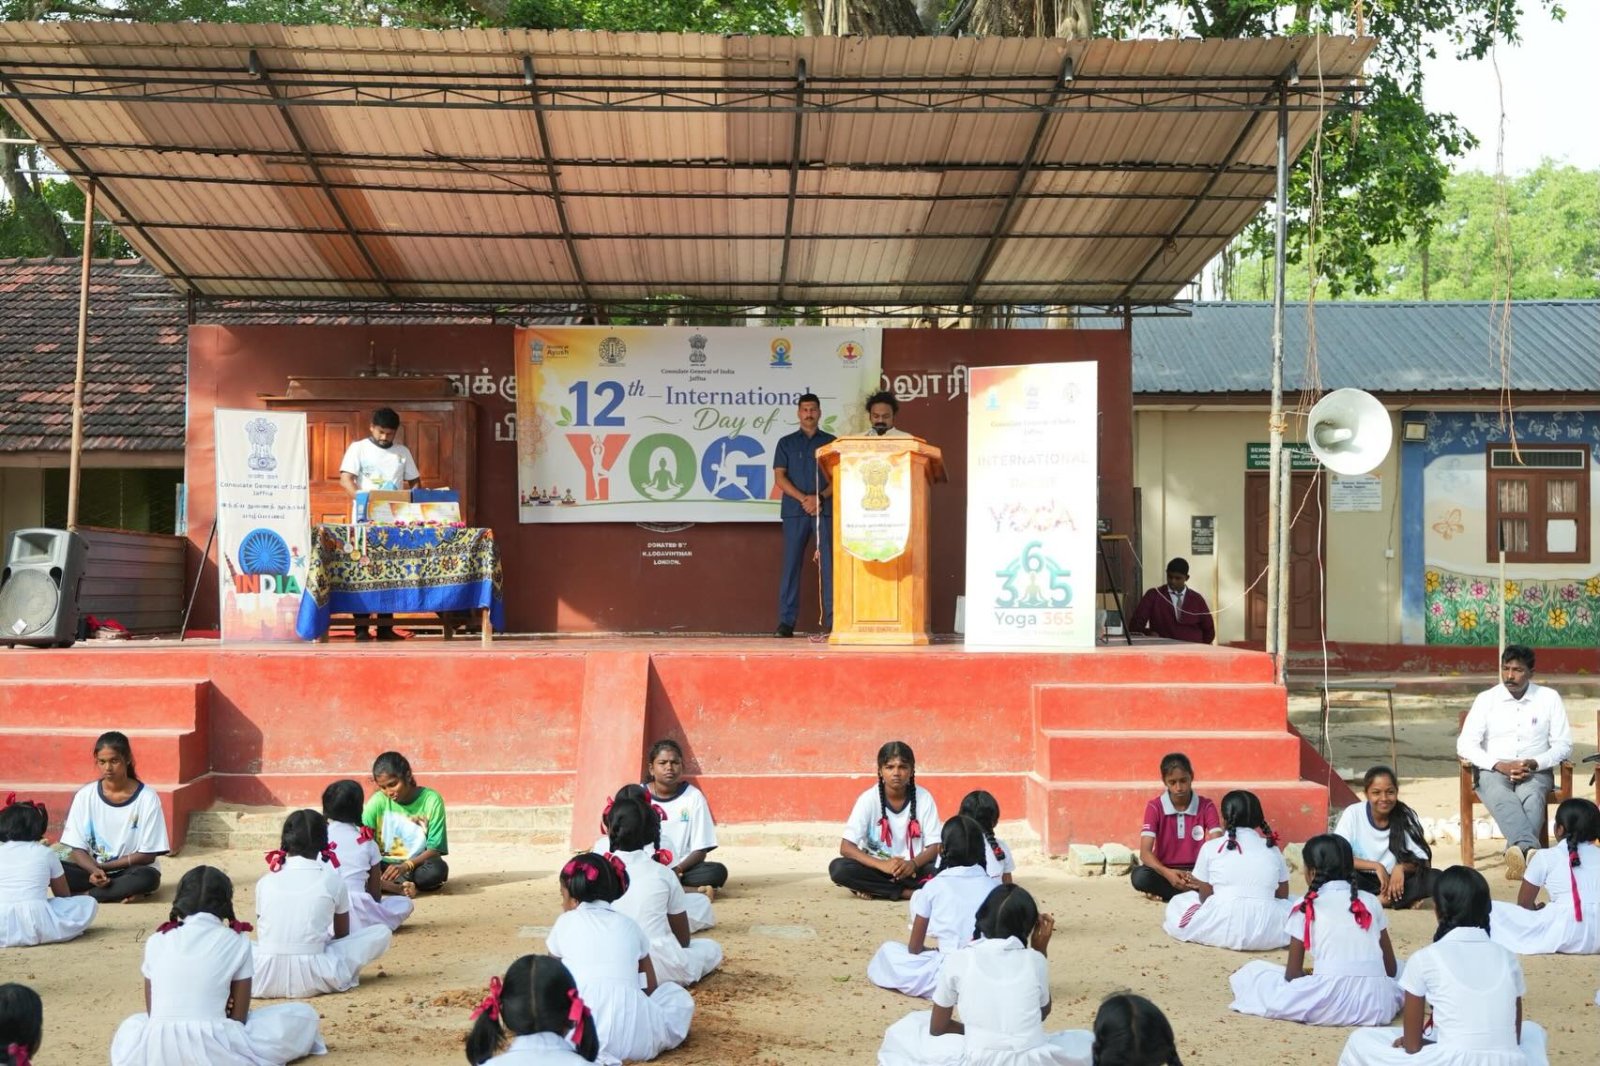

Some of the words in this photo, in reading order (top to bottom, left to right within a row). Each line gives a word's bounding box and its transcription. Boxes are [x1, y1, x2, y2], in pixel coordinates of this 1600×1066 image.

[692, 406, 748, 440] Day
[752, 407, 781, 435] of
[565, 432, 784, 502] YOG
[235, 573, 302, 594] INDIA
[994, 612, 1037, 629] Yoga
[1042, 611, 1074, 625] 365
